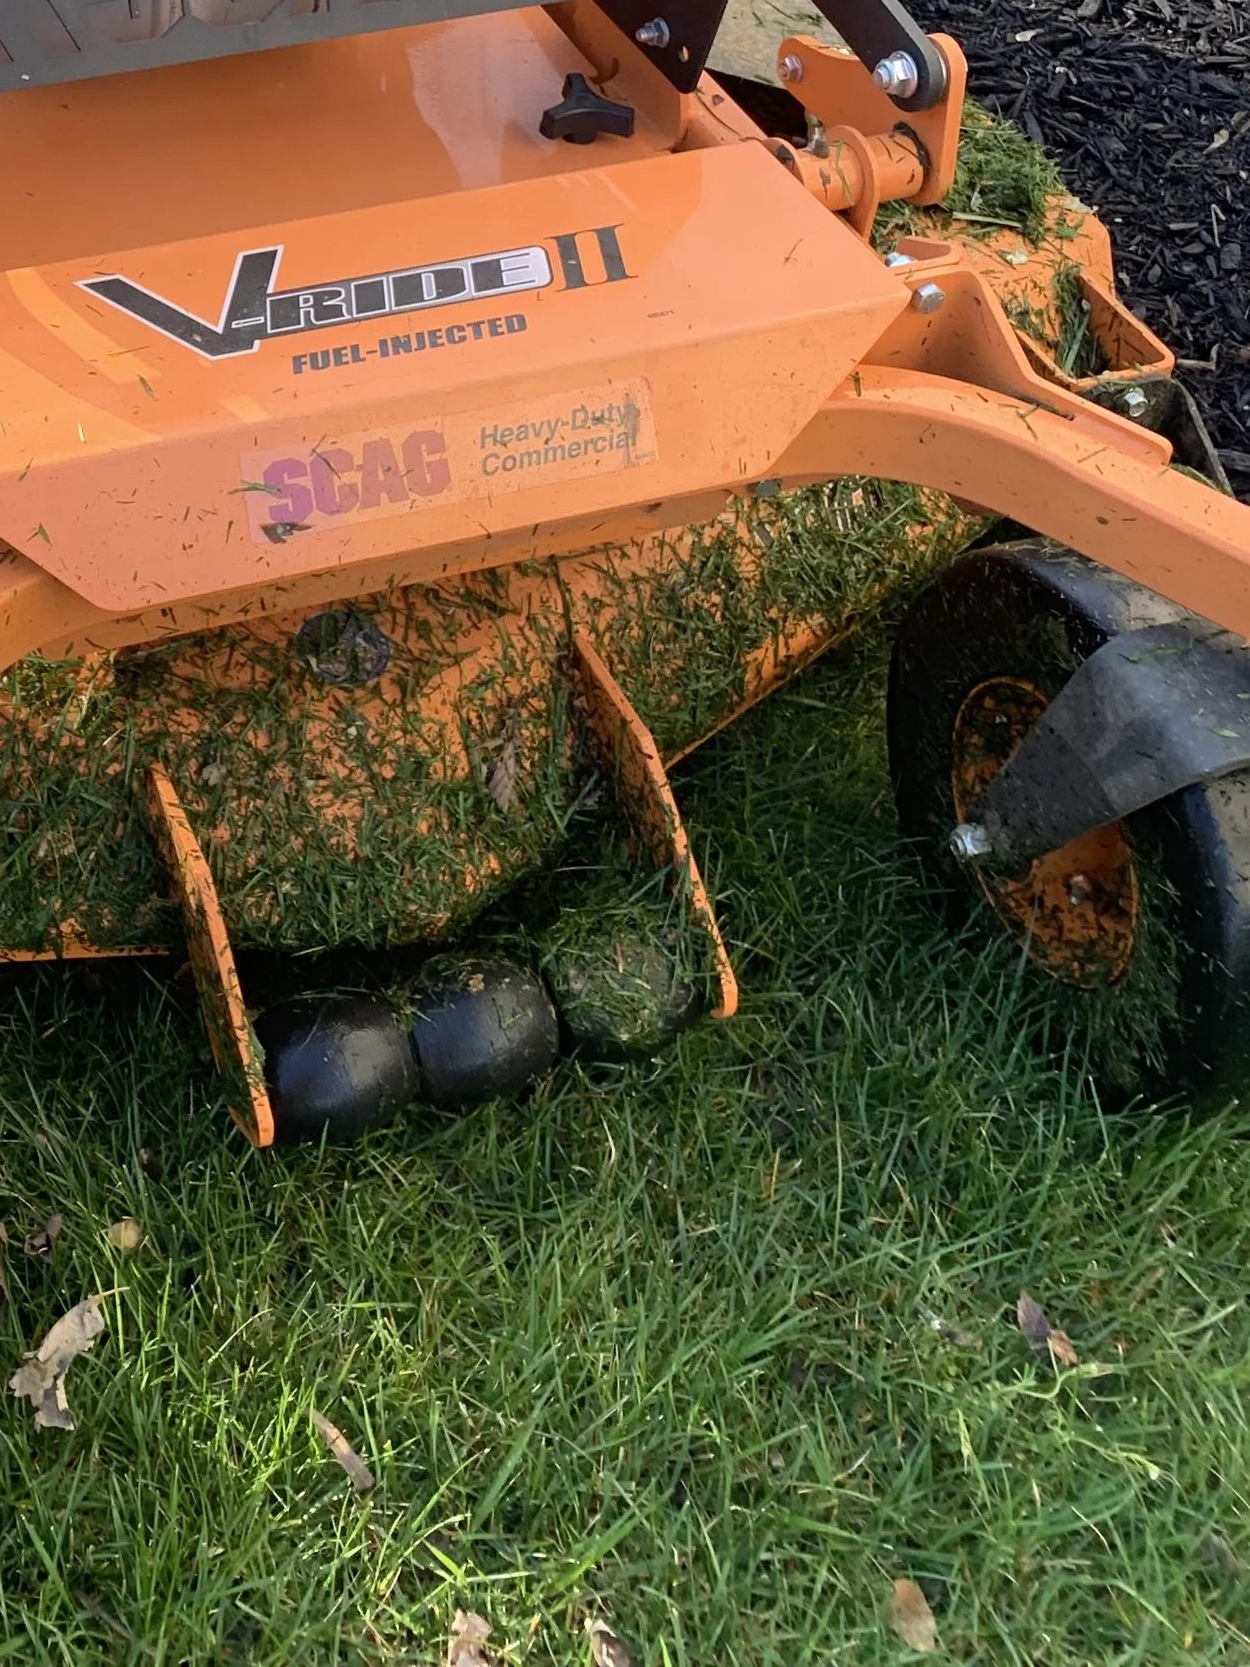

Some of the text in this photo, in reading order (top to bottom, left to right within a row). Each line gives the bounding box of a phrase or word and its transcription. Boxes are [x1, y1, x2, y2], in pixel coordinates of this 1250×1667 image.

[72, 223, 639, 361] V-RIDE II
[292, 313, 528, 375] FUEL-INJECTED
[479, 400, 631, 450] Heavy-Duty
[480, 426, 638, 477] Commercial
[261, 429, 452, 525] SCAG
